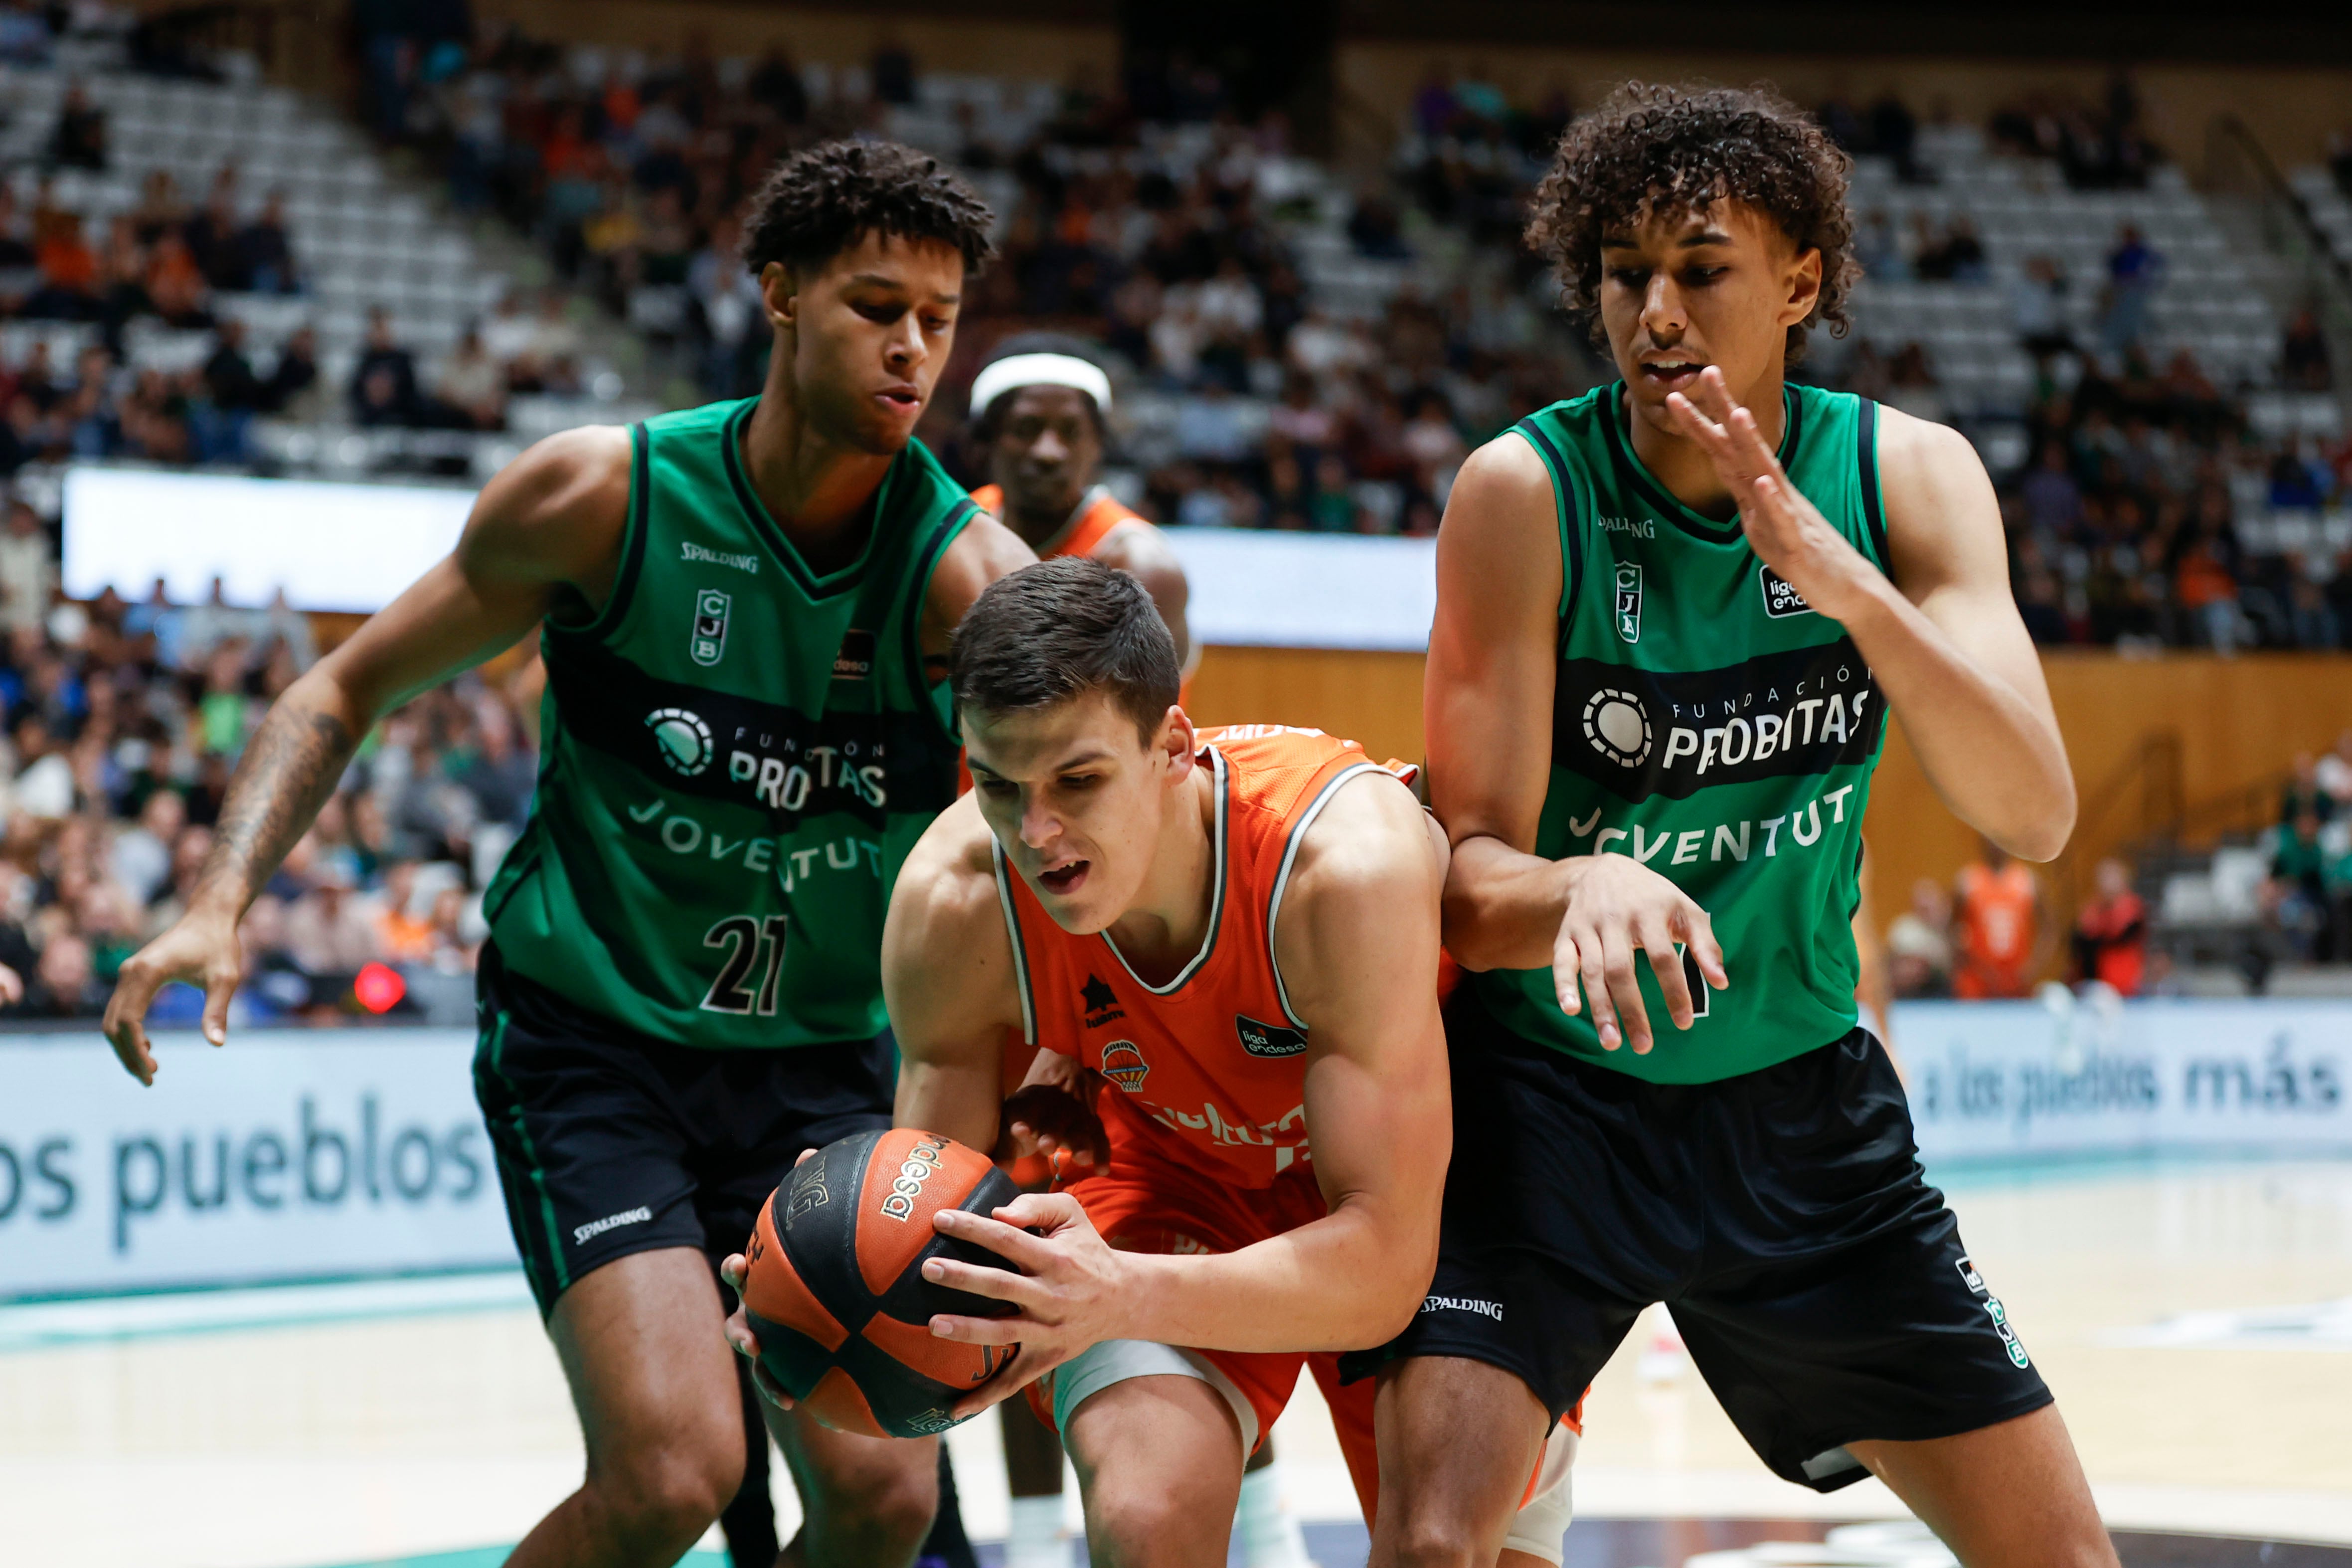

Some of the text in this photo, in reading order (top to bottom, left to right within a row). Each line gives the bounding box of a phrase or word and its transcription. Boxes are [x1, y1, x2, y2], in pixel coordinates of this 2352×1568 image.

[681, 542, 758, 574] SPALDING
[833, 659, 869, 672] desa
[728, 745, 887, 812] PROTAS
[699, 914, 789, 1017] 21
[1242, 1030, 1268, 1045] liga
[1248, 1043, 1307, 1054] endesa
[2184, 1030, 2342, 1107] más
[111, 1090, 485, 1255] pueblos
[574, 1206, 652, 1246] SPALDING
[1420, 1296, 1503, 1321] SPALDING
